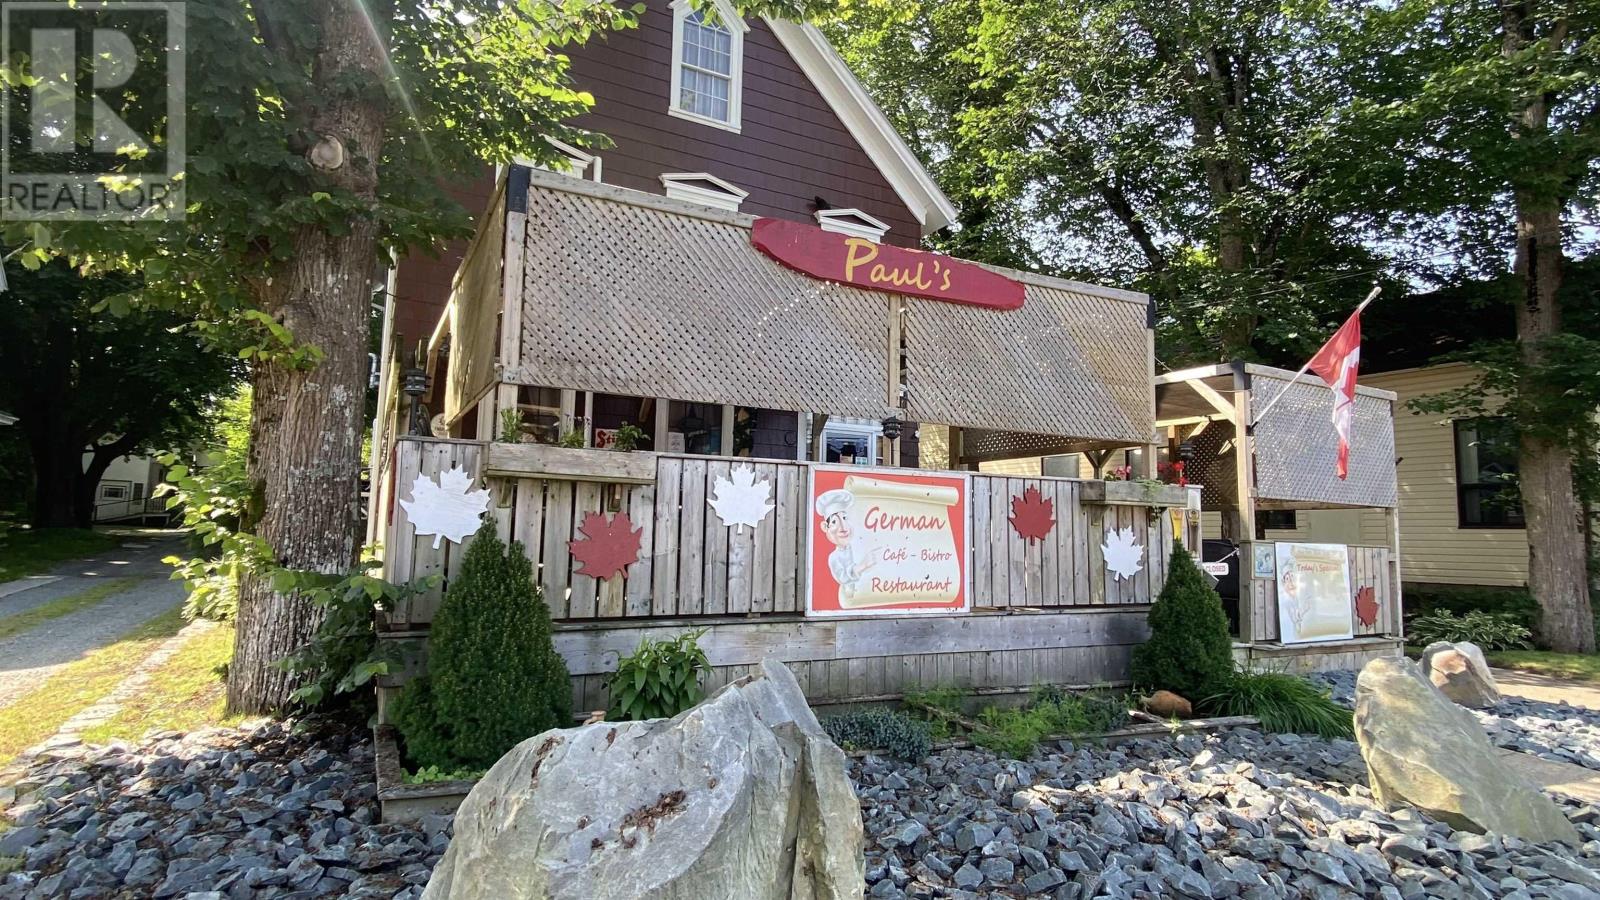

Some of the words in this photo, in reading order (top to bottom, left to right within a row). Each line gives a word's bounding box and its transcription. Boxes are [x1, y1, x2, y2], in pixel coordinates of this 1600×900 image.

[844, 237, 951, 291] Paul's
[864, 506, 946, 532] German
[883, 547, 907, 565] Café
[921, 548, 952, 561] Bistro
[872, 577, 952, 593] Restaurant
